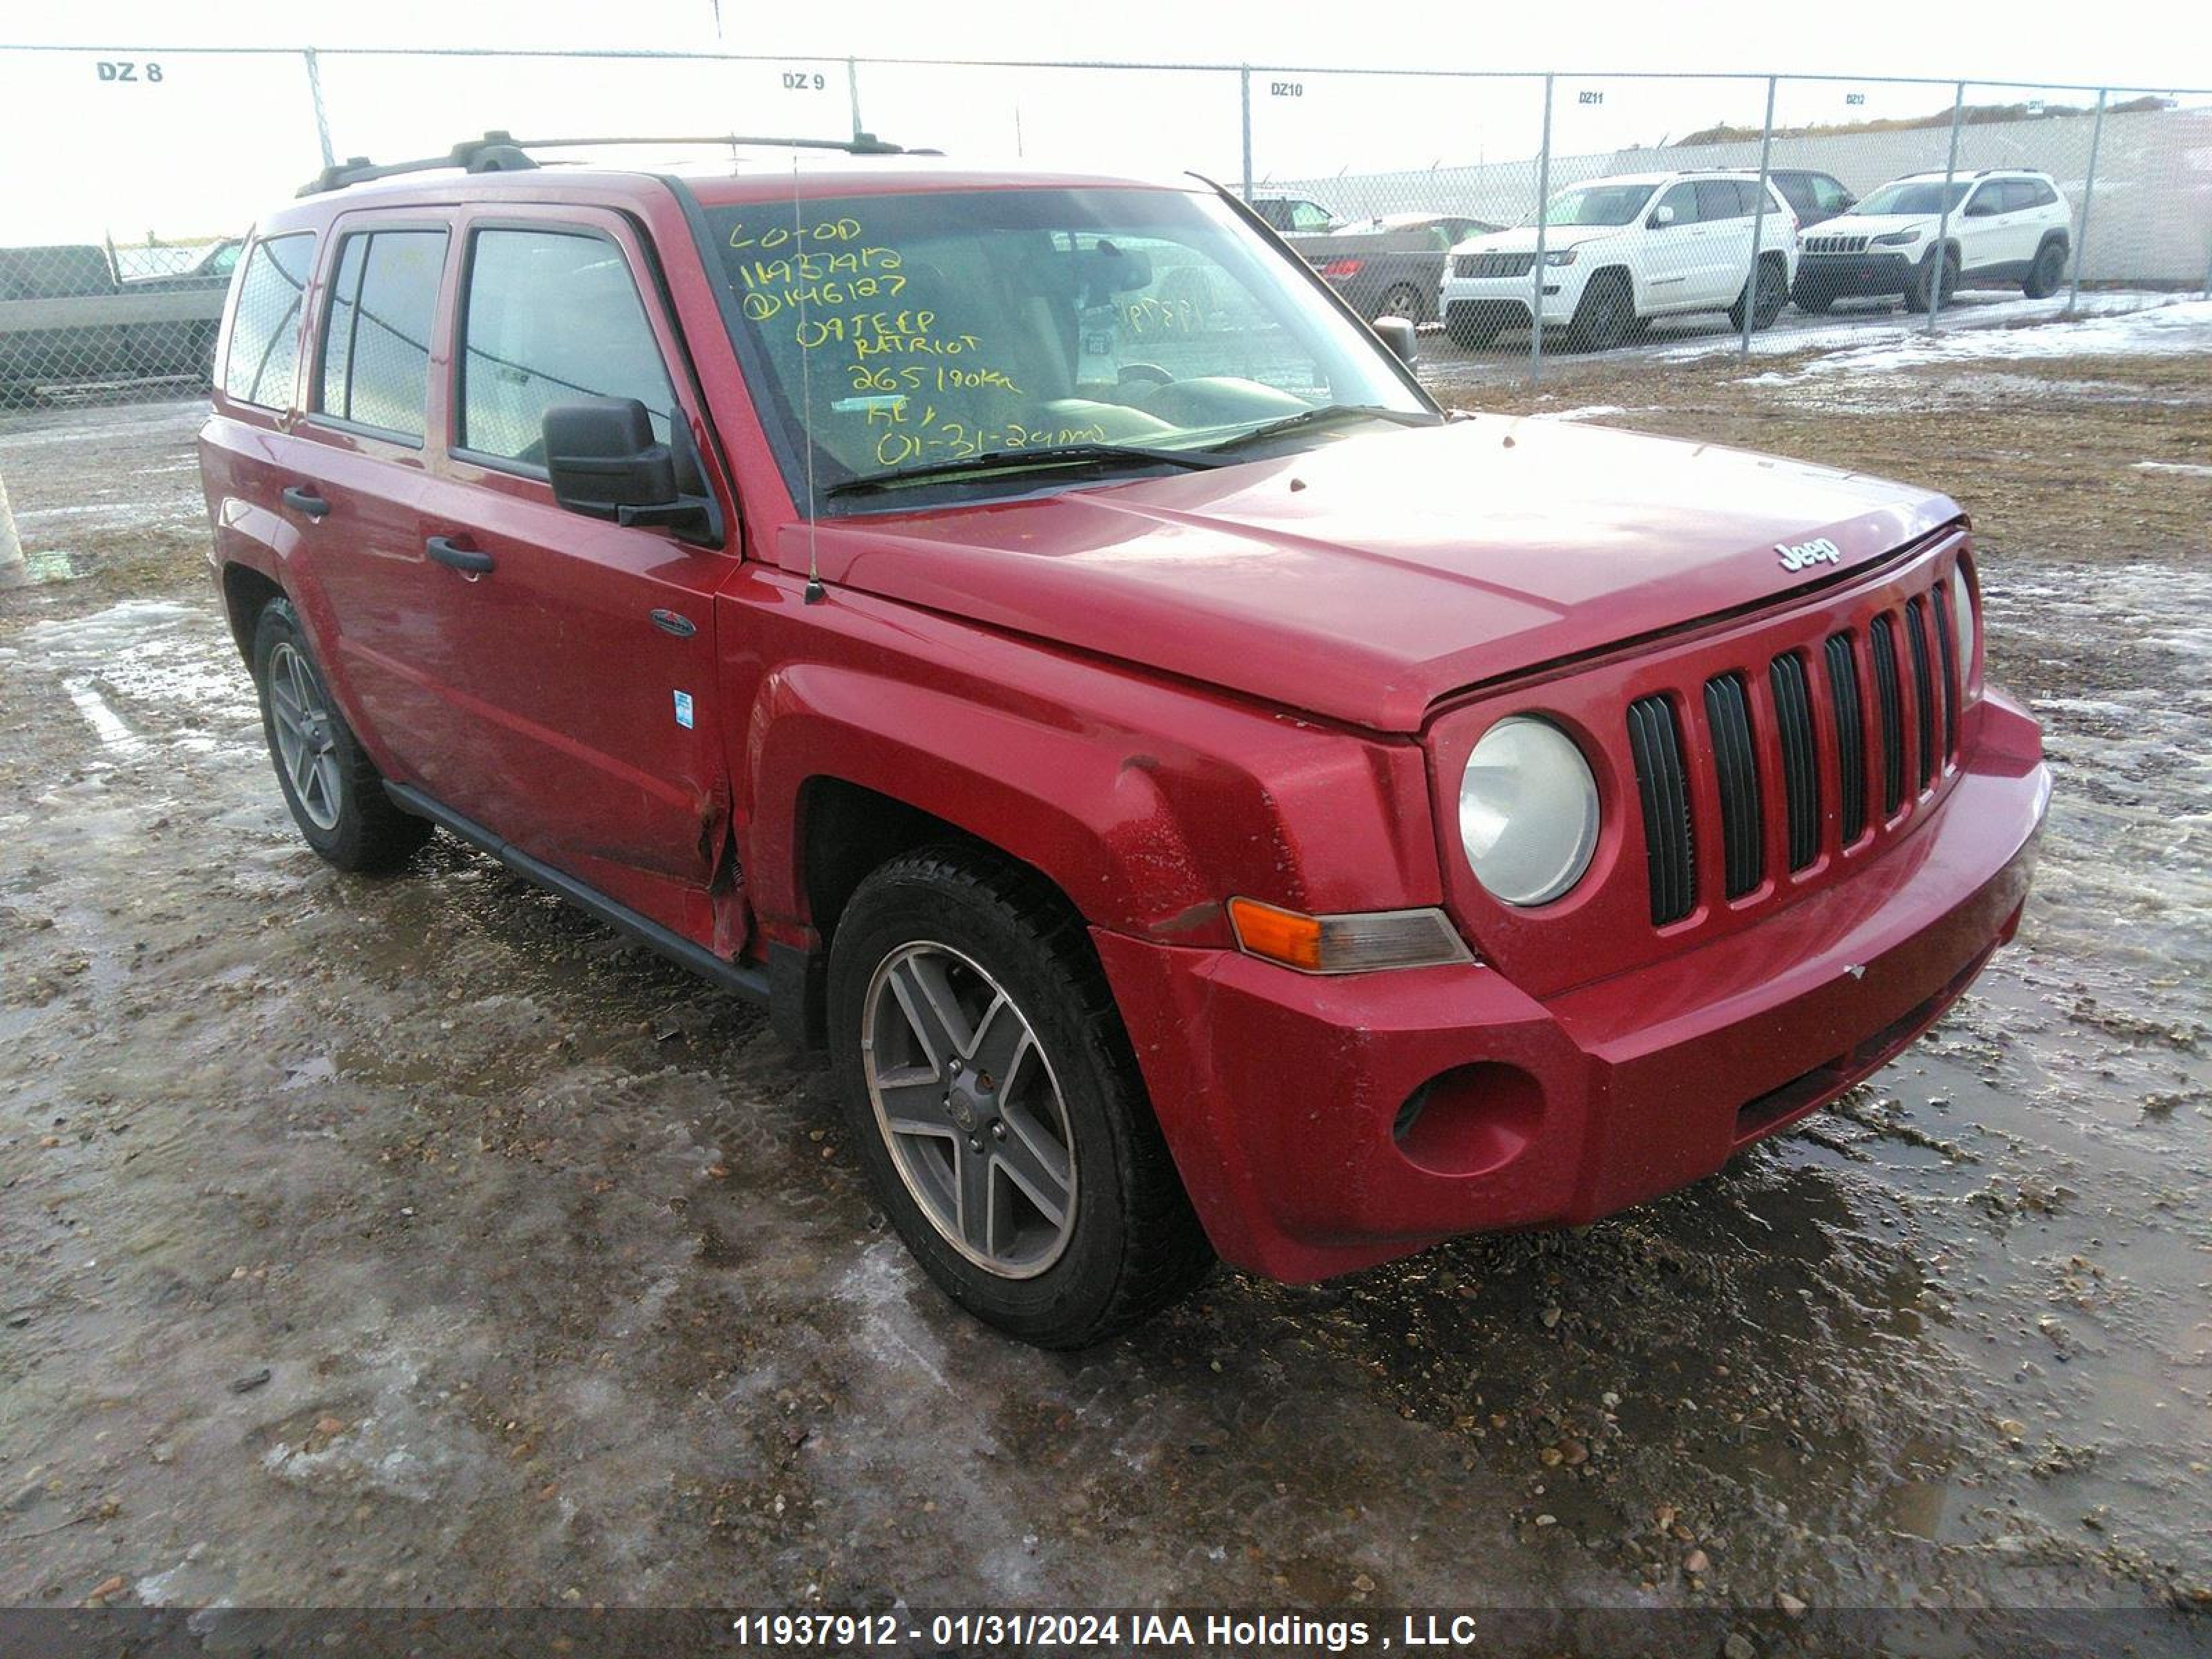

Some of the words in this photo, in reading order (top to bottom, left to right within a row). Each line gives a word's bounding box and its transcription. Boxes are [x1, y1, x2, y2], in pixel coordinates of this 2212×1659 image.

[97, 62, 138, 82] DZ
[146, 63, 163, 82] 8
[782, 73, 808, 89] DZ
[814, 74, 825, 91] 9
[1271, 82, 1303, 97] DZ10
[1579, 91, 1603, 104] DZ11
[796, 317, 843, 348] 09
[852, 310, 935, 337] JEEP
[853, 335, 985, 360] PATRIOT
[1772, 537, 1840, 573] Jeep
